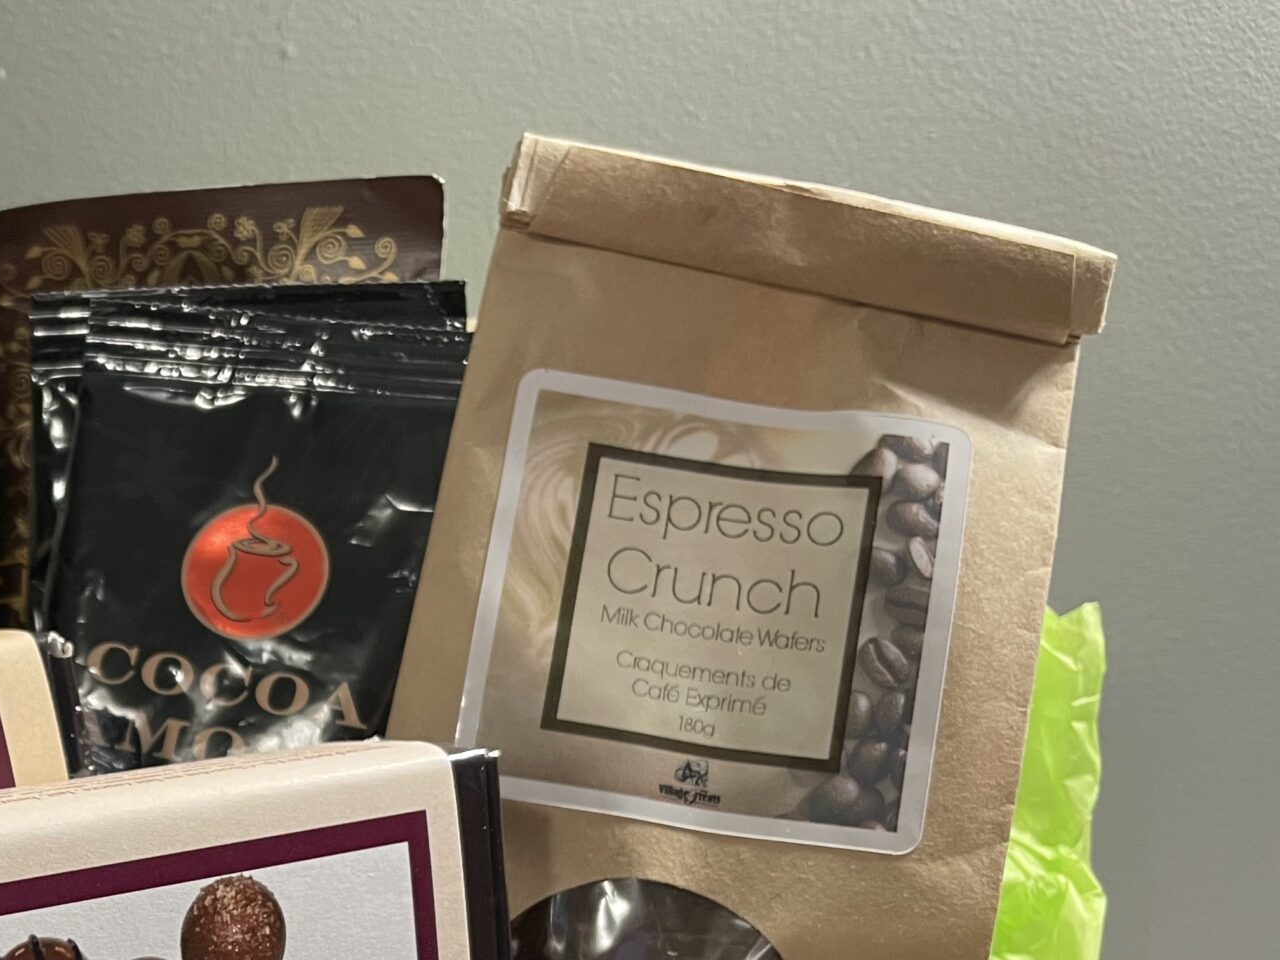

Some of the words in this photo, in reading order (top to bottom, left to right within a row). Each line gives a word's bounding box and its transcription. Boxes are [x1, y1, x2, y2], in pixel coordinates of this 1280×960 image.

[607, 473, 844, 547] Espresso
[607, 547, 822, 619] Crunch
[600, 604, 639, 629] Milk
[643, 611, 754, 647] Chocolate
[757, 630, 826, 653] Wafers
[86, 641, 367, 730] COCOA
[616, 650, 756, 690] Craquements
[761, 672, 791, 692] de
[631, 678, 681, 703] Café
[686, 686, 767, 716] Exprimé
[679, 715, 715, 738] 180g
